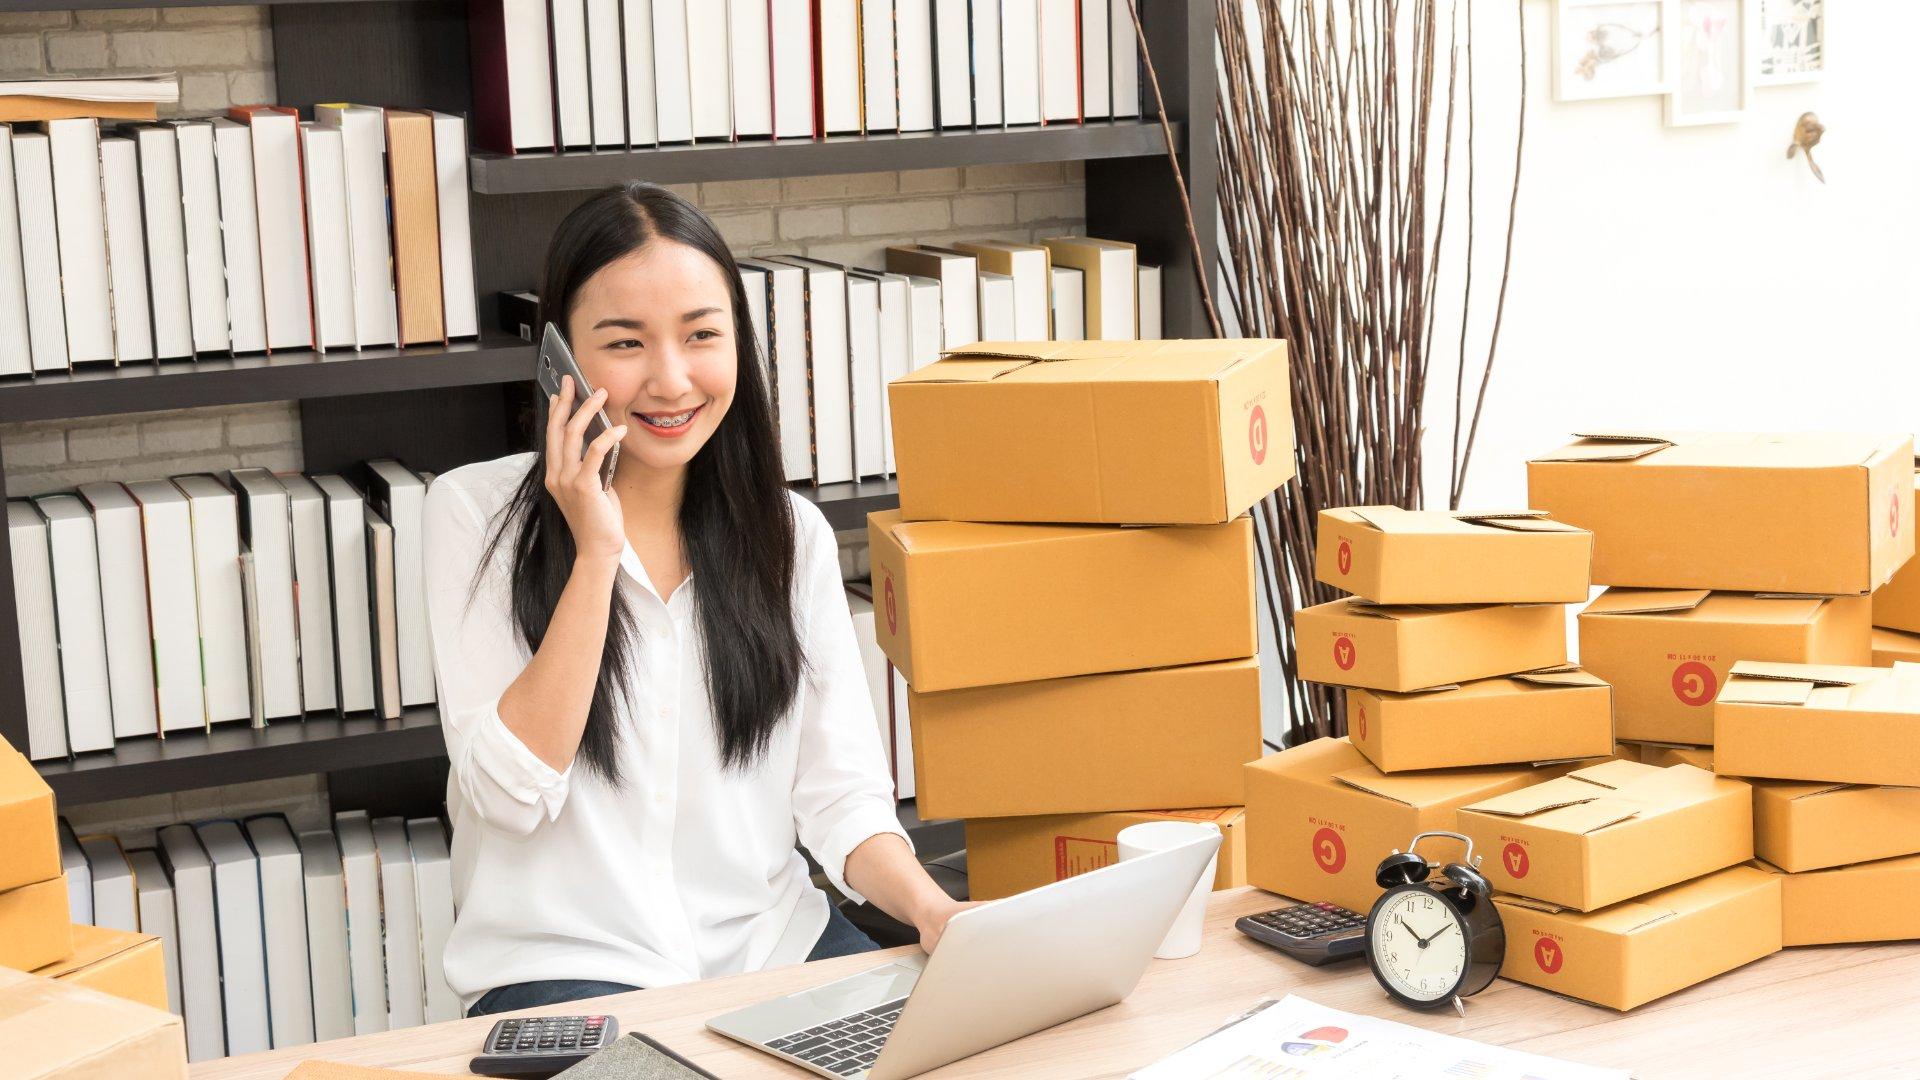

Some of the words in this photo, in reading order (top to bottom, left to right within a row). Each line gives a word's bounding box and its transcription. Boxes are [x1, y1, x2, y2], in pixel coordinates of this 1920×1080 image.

[1406, 900, 1415, 913] 11
[1423, 897, 1434, 910] 12
[1394, 912, 1403, 926] 10
[1386, 930, 1393, 942] 9
[1390, 952, 1398, 964] 8
[1404, 968, 1411, 980] 7
[1452, 965, 1459, 976] 4
[1420, 978, 1427, 990] 6
[1439, 977, 1446, 989] 5
